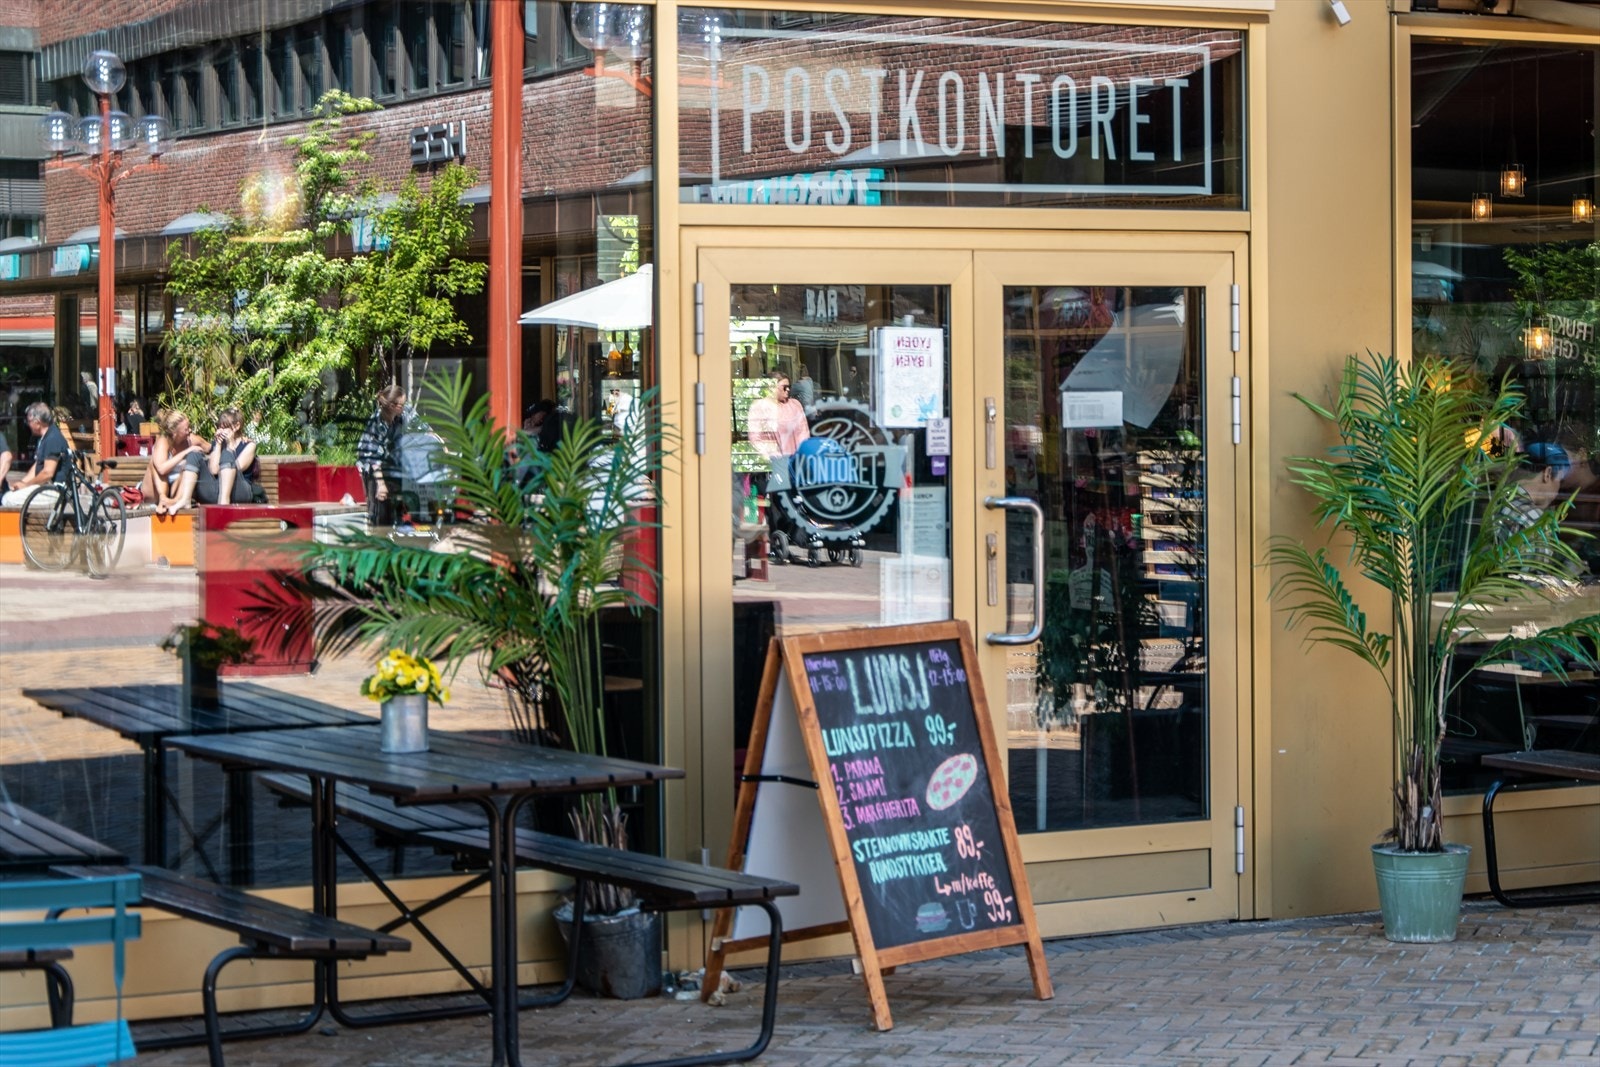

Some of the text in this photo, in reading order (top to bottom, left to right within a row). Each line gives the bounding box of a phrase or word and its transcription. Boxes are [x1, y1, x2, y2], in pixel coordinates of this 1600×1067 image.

[741, 65, 1189, 162] POSTKONTORET
[805, 289, 838, 320] BAR
[795, 452, 879, 487] KONTORET
[845, 653, 931, 715] LUNSJ
[822, 721, 915, 756] LUNSJPIZZA
[844, 756, 884, 780] PARMA
[836, 777, 887, 805] 2. SALAMI
[840, 797, 921, 830] 3. MARGHERITA
[852, 827, 951, 863] STEINOVNSBAKTE
[868, 852, 948, 885] RUNDSTYKKER
